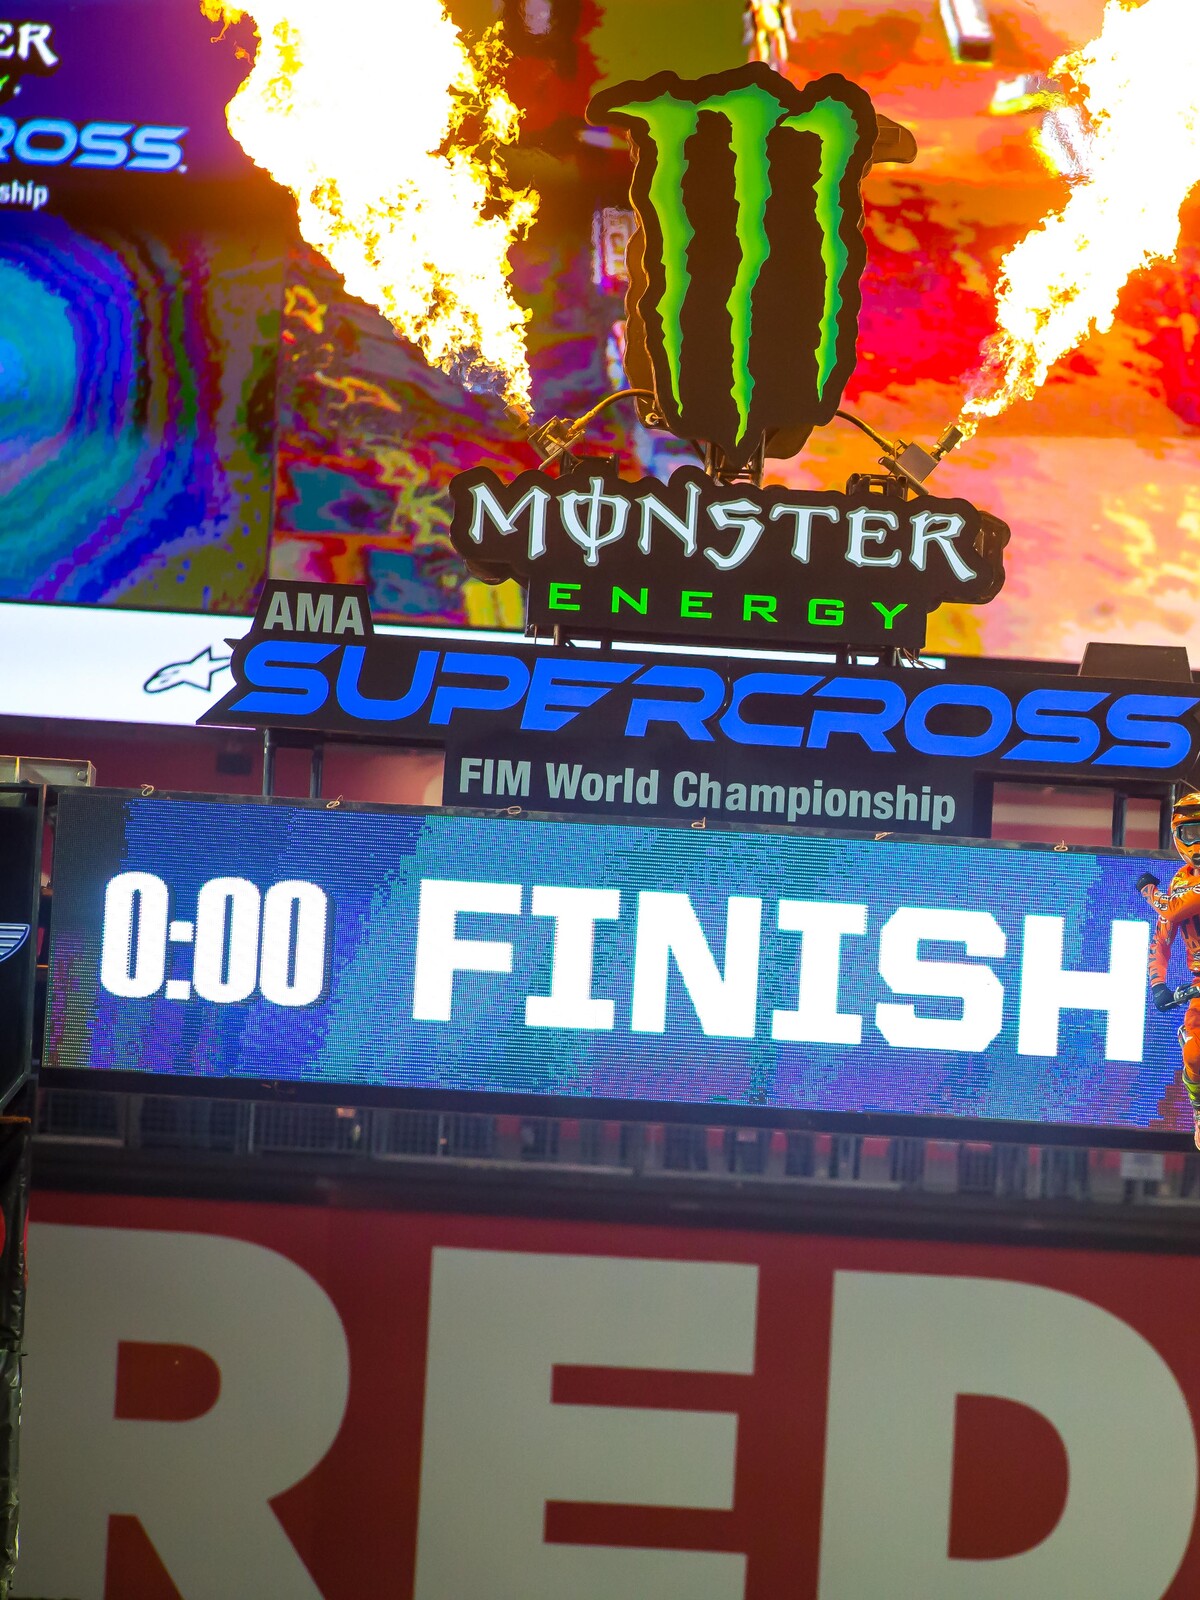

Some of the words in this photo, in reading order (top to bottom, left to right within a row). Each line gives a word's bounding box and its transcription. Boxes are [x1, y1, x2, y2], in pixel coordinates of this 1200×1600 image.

[468, 476, 978, 583] MONSTER
[262, 591, 365, 636] AMA
[549, 582, 908, 630] ENERGY
[459, 757, 532, 797] FIM
[546, 762, 659, 804] World
[673, 769, 956, 830] Championship
[100, 871, 329, 1007] 0:00
[413, 879, 1150, 1063] FINISH
